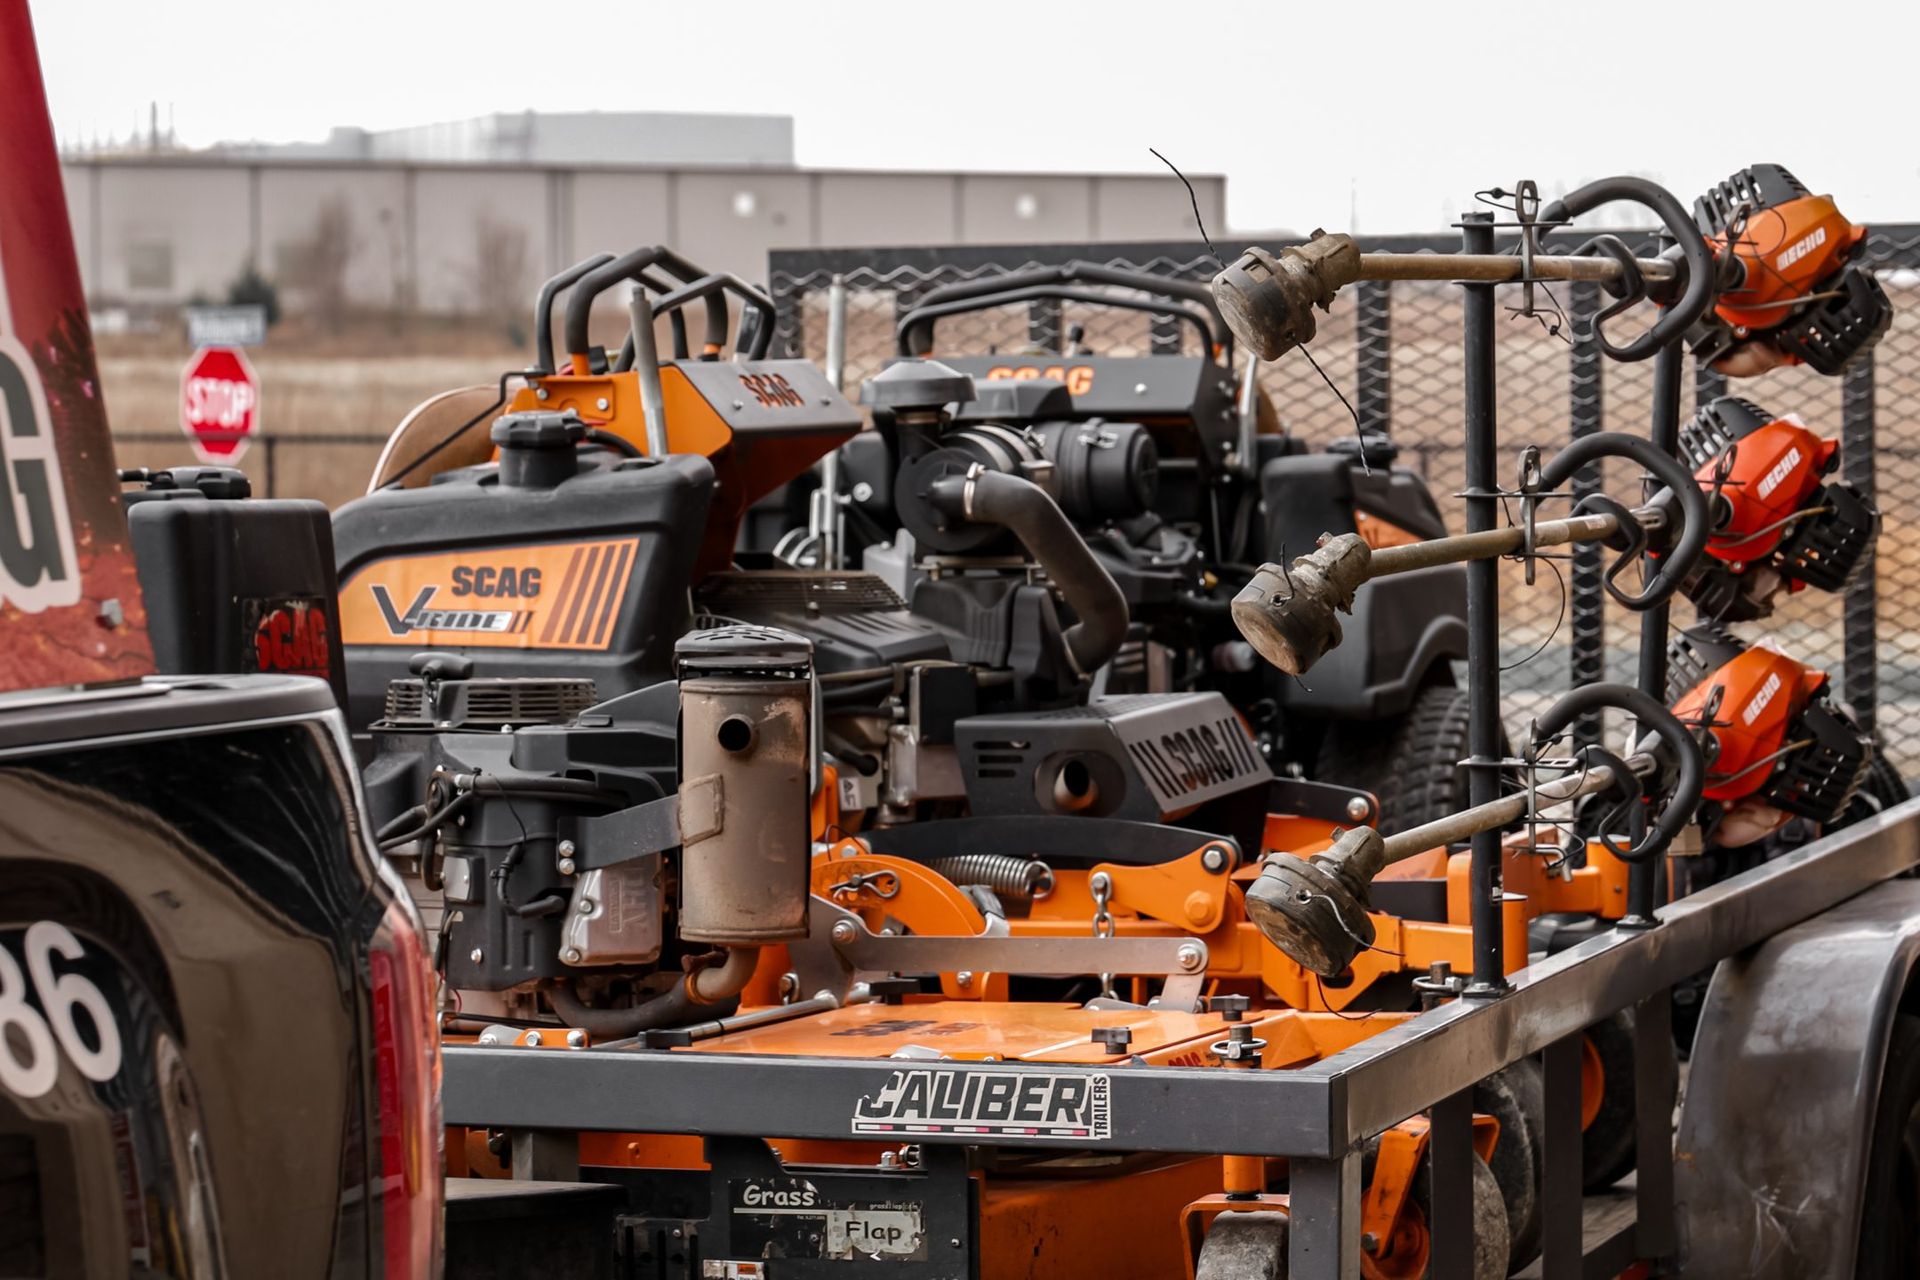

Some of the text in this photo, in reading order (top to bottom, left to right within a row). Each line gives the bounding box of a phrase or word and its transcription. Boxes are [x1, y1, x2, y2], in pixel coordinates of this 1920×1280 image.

[1785, 226, 1827, 267] ECHO
[185, 376, 255, 428] STOP
[738, 373, 806, 407] SCAG
[1764, 447, 1801, 494] ECHO
[451, 566, 542, 598] SCAG
[255, 608, 329, 671] SCAG
[1748, 672, 1781, 719] ECHO
[1161, 724, 1235, 791] SCAG
[858, 1071, 1108, 1137] CALIBER TRAILERS
[743, 1184, 815, 1207] Grass
[846, 1221, 902, 1246] Flap
